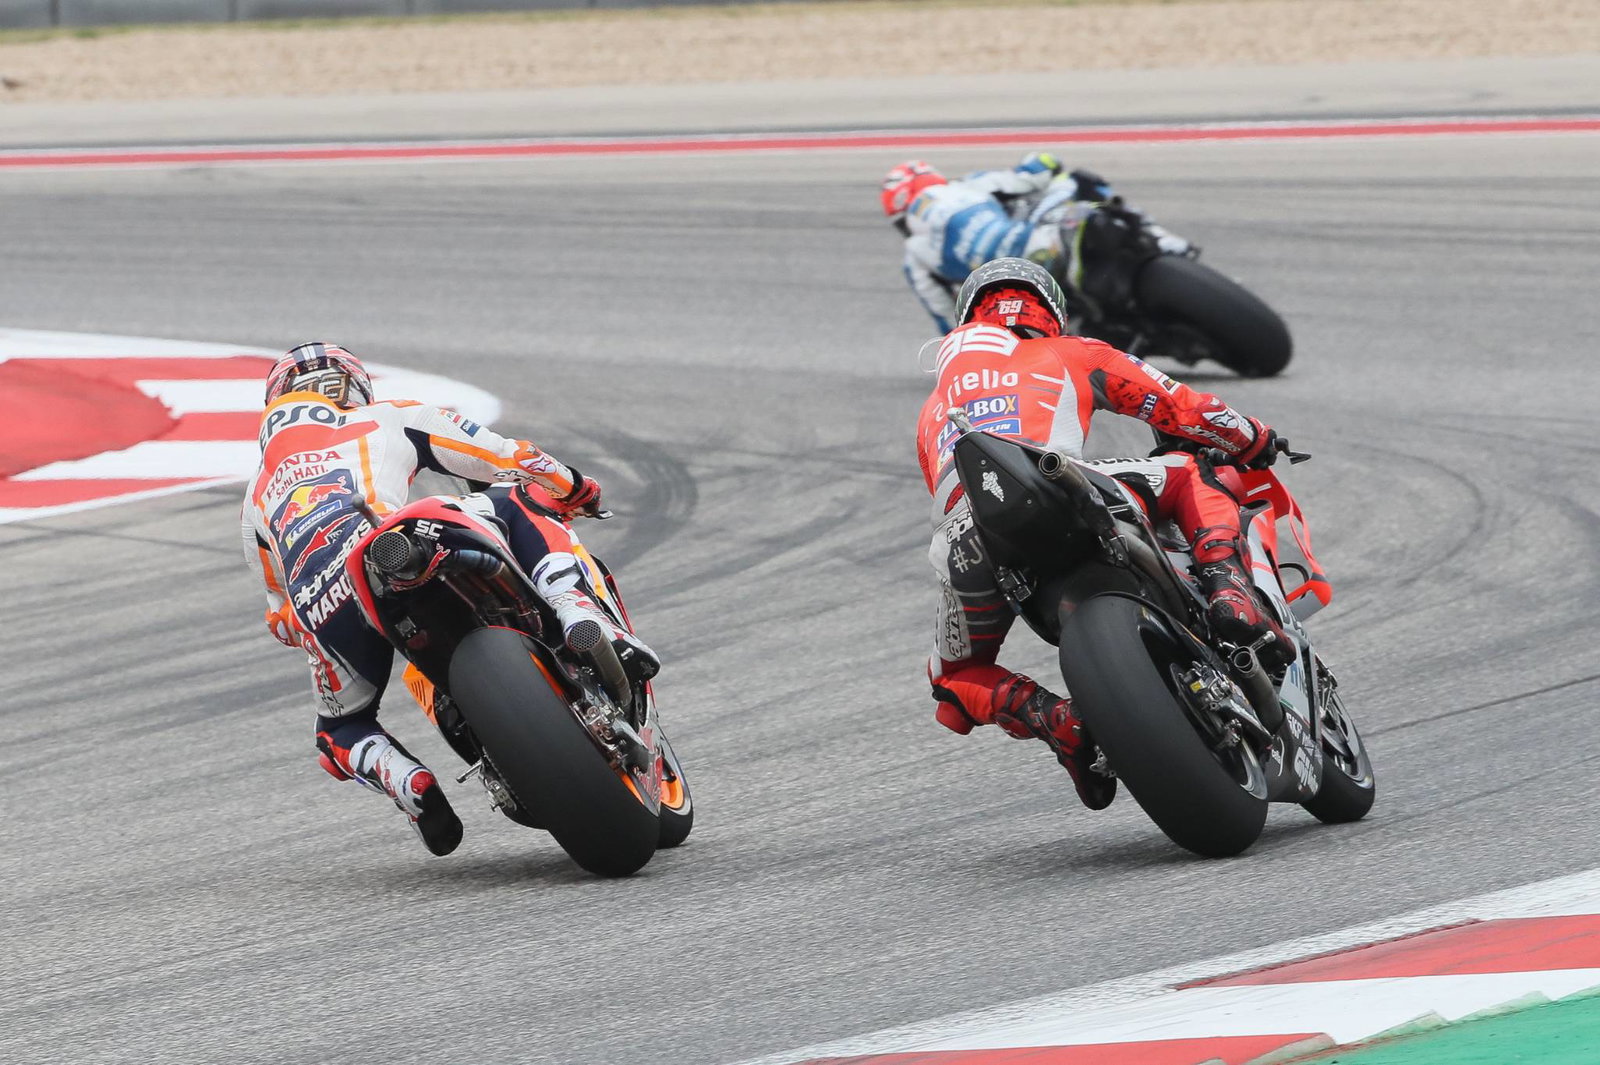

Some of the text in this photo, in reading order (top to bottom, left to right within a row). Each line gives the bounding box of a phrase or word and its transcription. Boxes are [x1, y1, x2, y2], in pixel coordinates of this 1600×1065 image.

[998, 299, 1023, 315] 69
[266, 450, 343, 502] HONDA
[414, 519, 443, 538] SC
